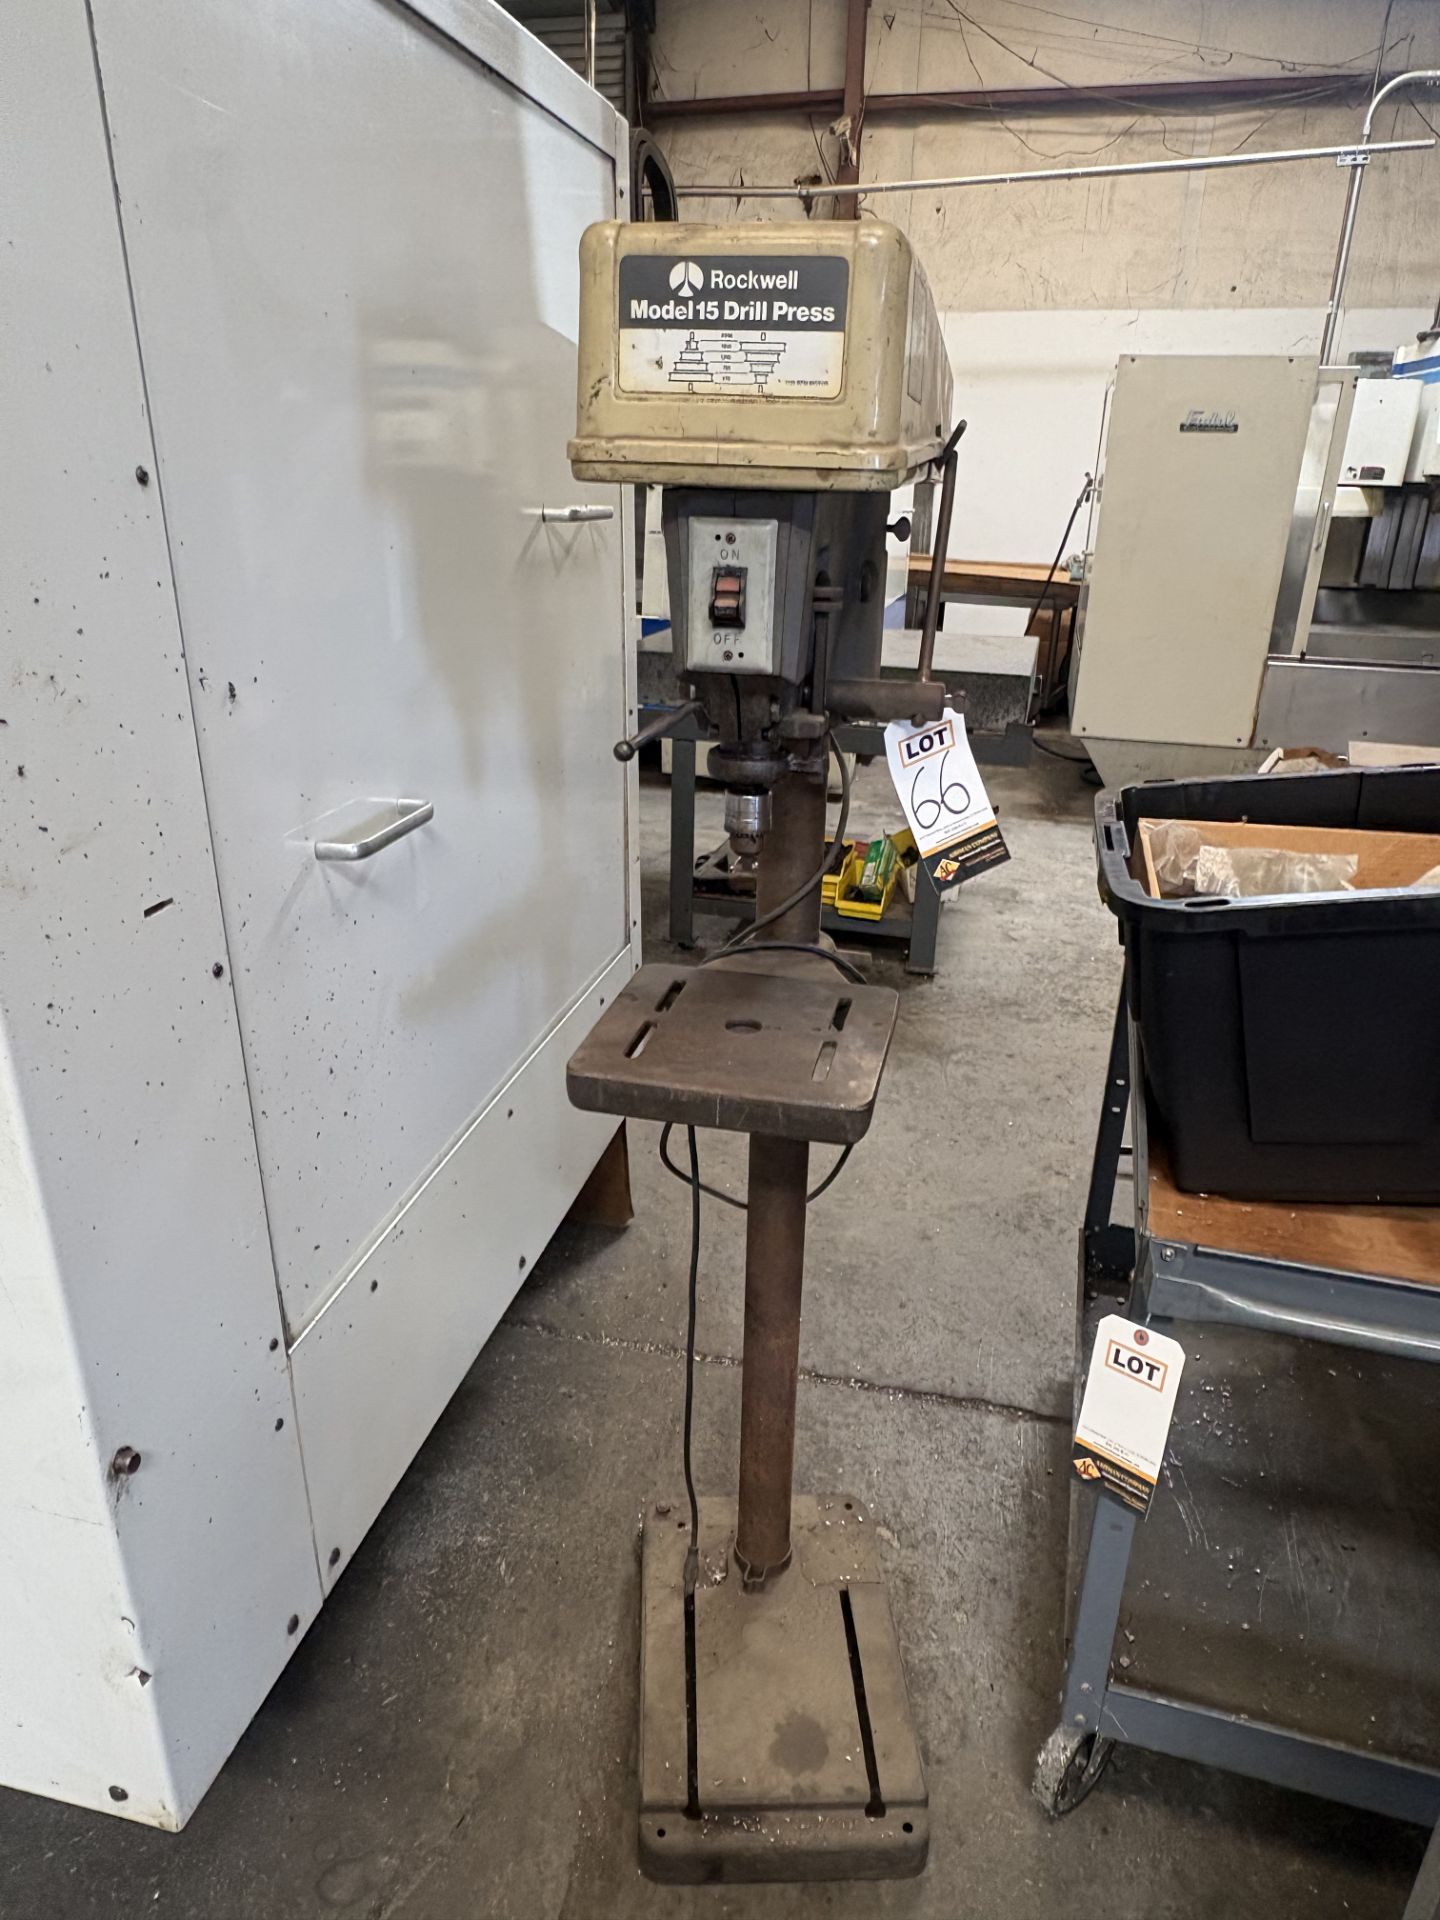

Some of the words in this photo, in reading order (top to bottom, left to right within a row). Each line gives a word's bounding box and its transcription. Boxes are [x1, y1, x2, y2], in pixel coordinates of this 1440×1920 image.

[710, 269, 799, 289] Rockwell
[630, 299, 693, 321] Model
[696, 301, 719, 320] 15
[723, 301, 767, 321] Drill
[772, 302, 835, 322] Press
[720, 549, 740, 561] ON
[713, 632, 742, 646] OFF
[905, 727, 948, 760] LOT
[911, 749, 971, 830] 66
[1112, 1348, 1161, 1382] LOT
